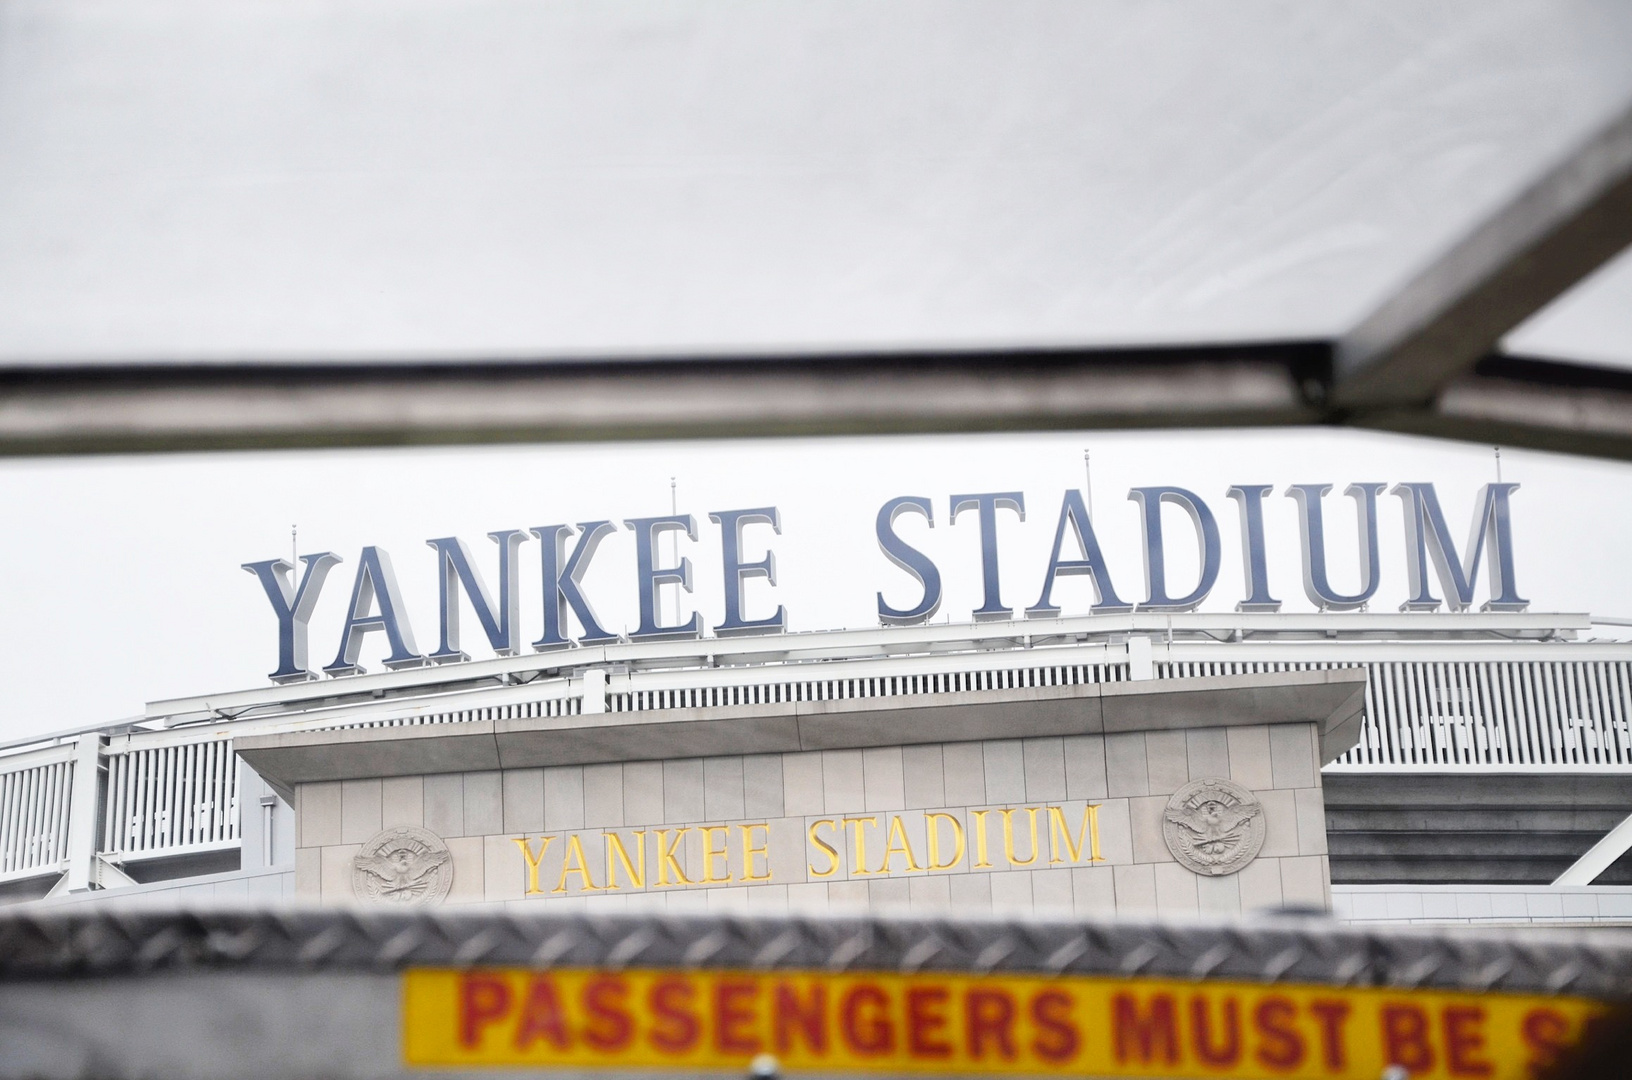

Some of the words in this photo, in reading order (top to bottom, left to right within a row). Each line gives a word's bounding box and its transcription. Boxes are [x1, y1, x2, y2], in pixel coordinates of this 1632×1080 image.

[240, 506, 788, 681] YANKEE
[876, 482, 1530, 621] STADIUM
[511, 822, 773, 895] YANKEE
[808, 803, 1106, 878] STADIUM
[457, 970, 1081, 1066] PASSENGERS
[1110, 991, 1353, 1074] MUST
[1379, 1003, 1495, 1079] BE
